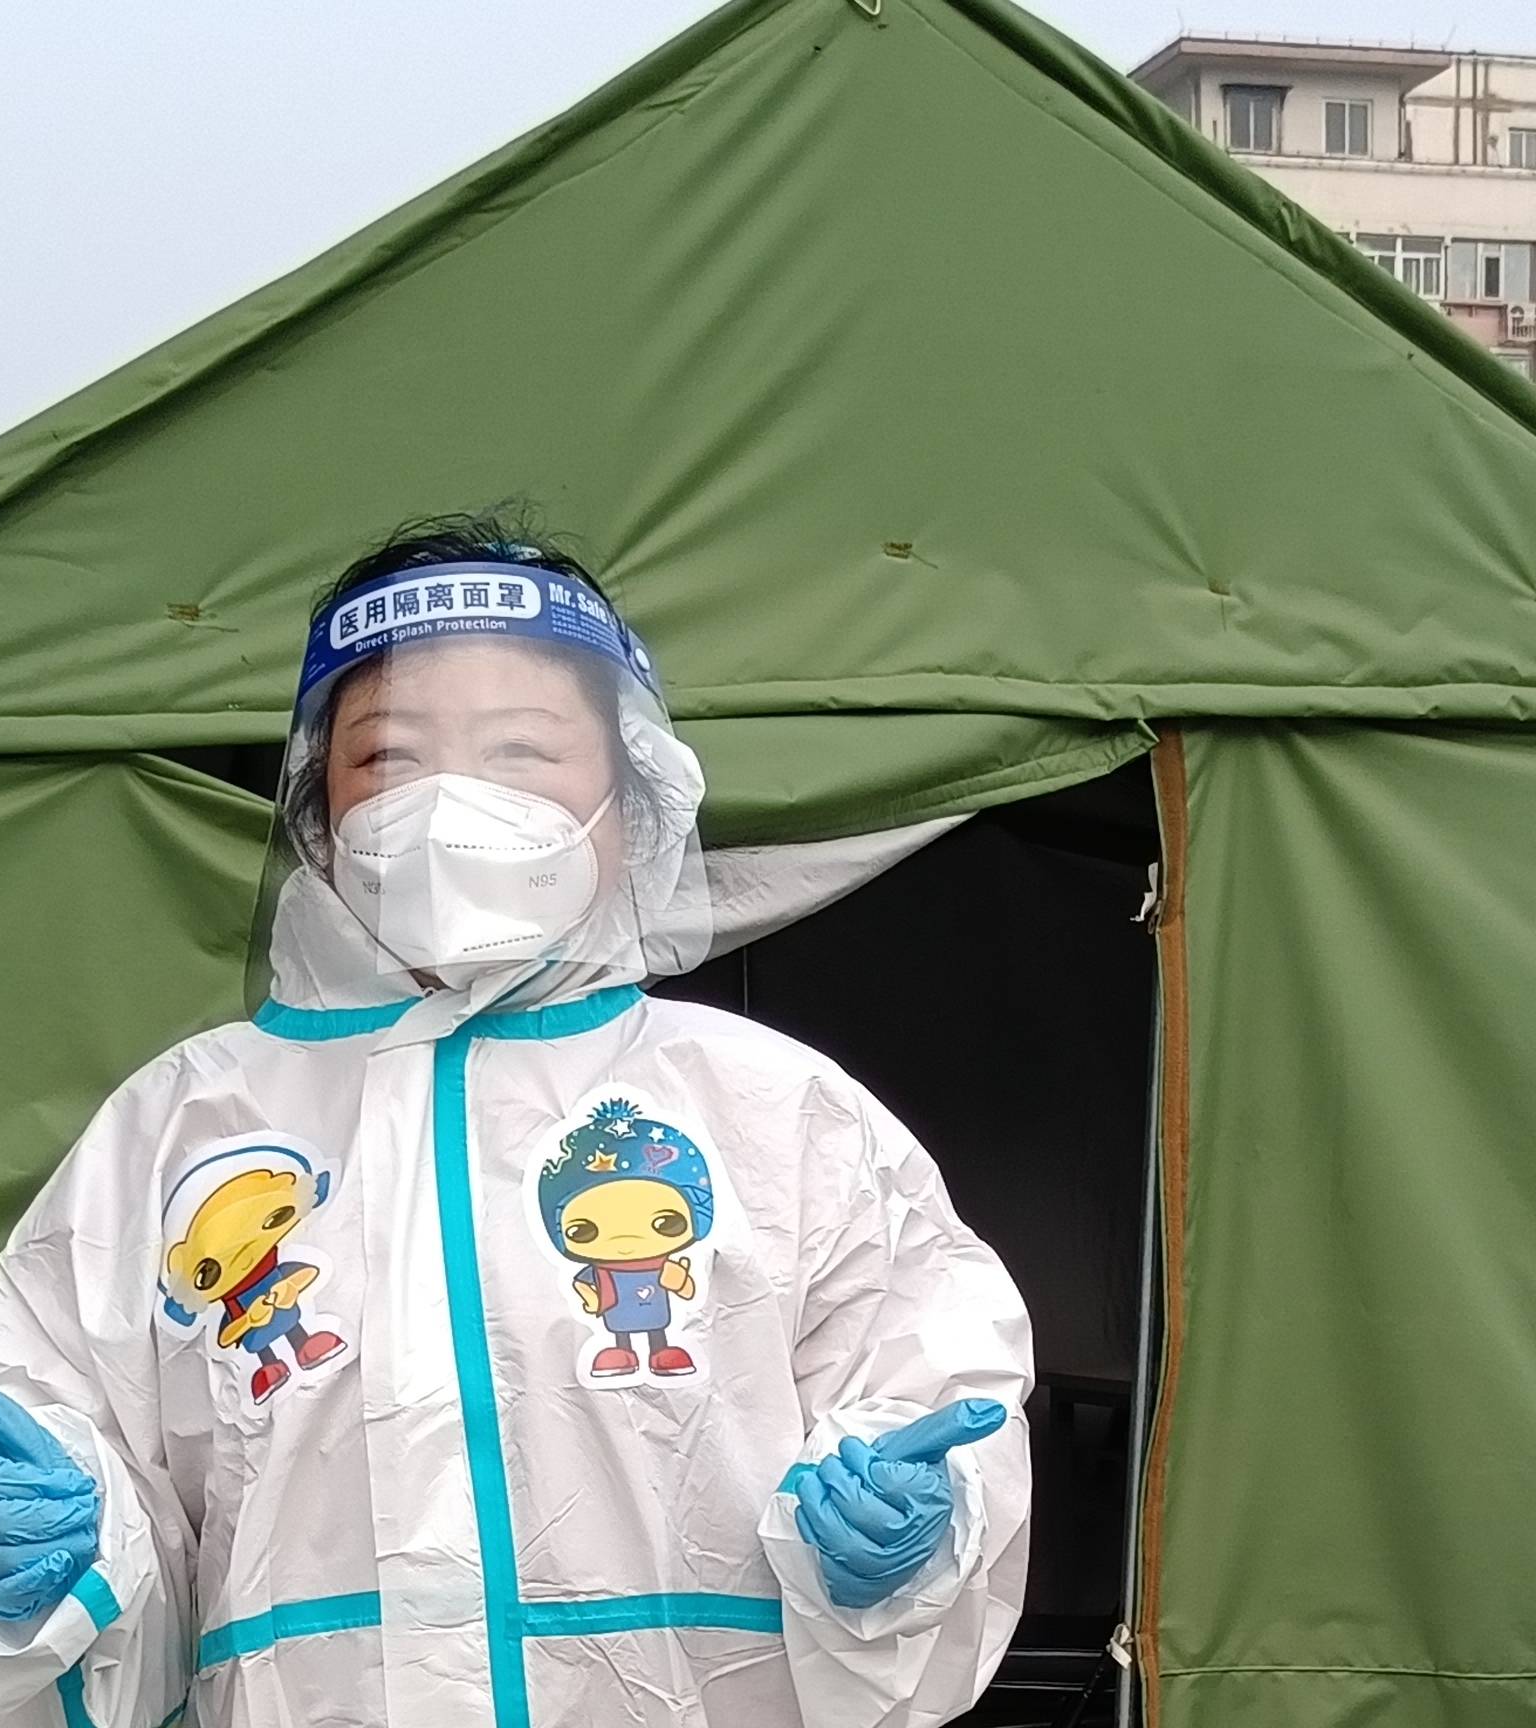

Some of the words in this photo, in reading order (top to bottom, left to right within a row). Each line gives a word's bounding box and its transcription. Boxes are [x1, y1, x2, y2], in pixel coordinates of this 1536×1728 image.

[339, 581, 526, 641] 医用隔离面罩
[355, 635, 389, 652] Direct
[392, 624, 432, 642] Splash
[436, 617, 507, 632] Protection
[528, 873, 558, 889] N95
